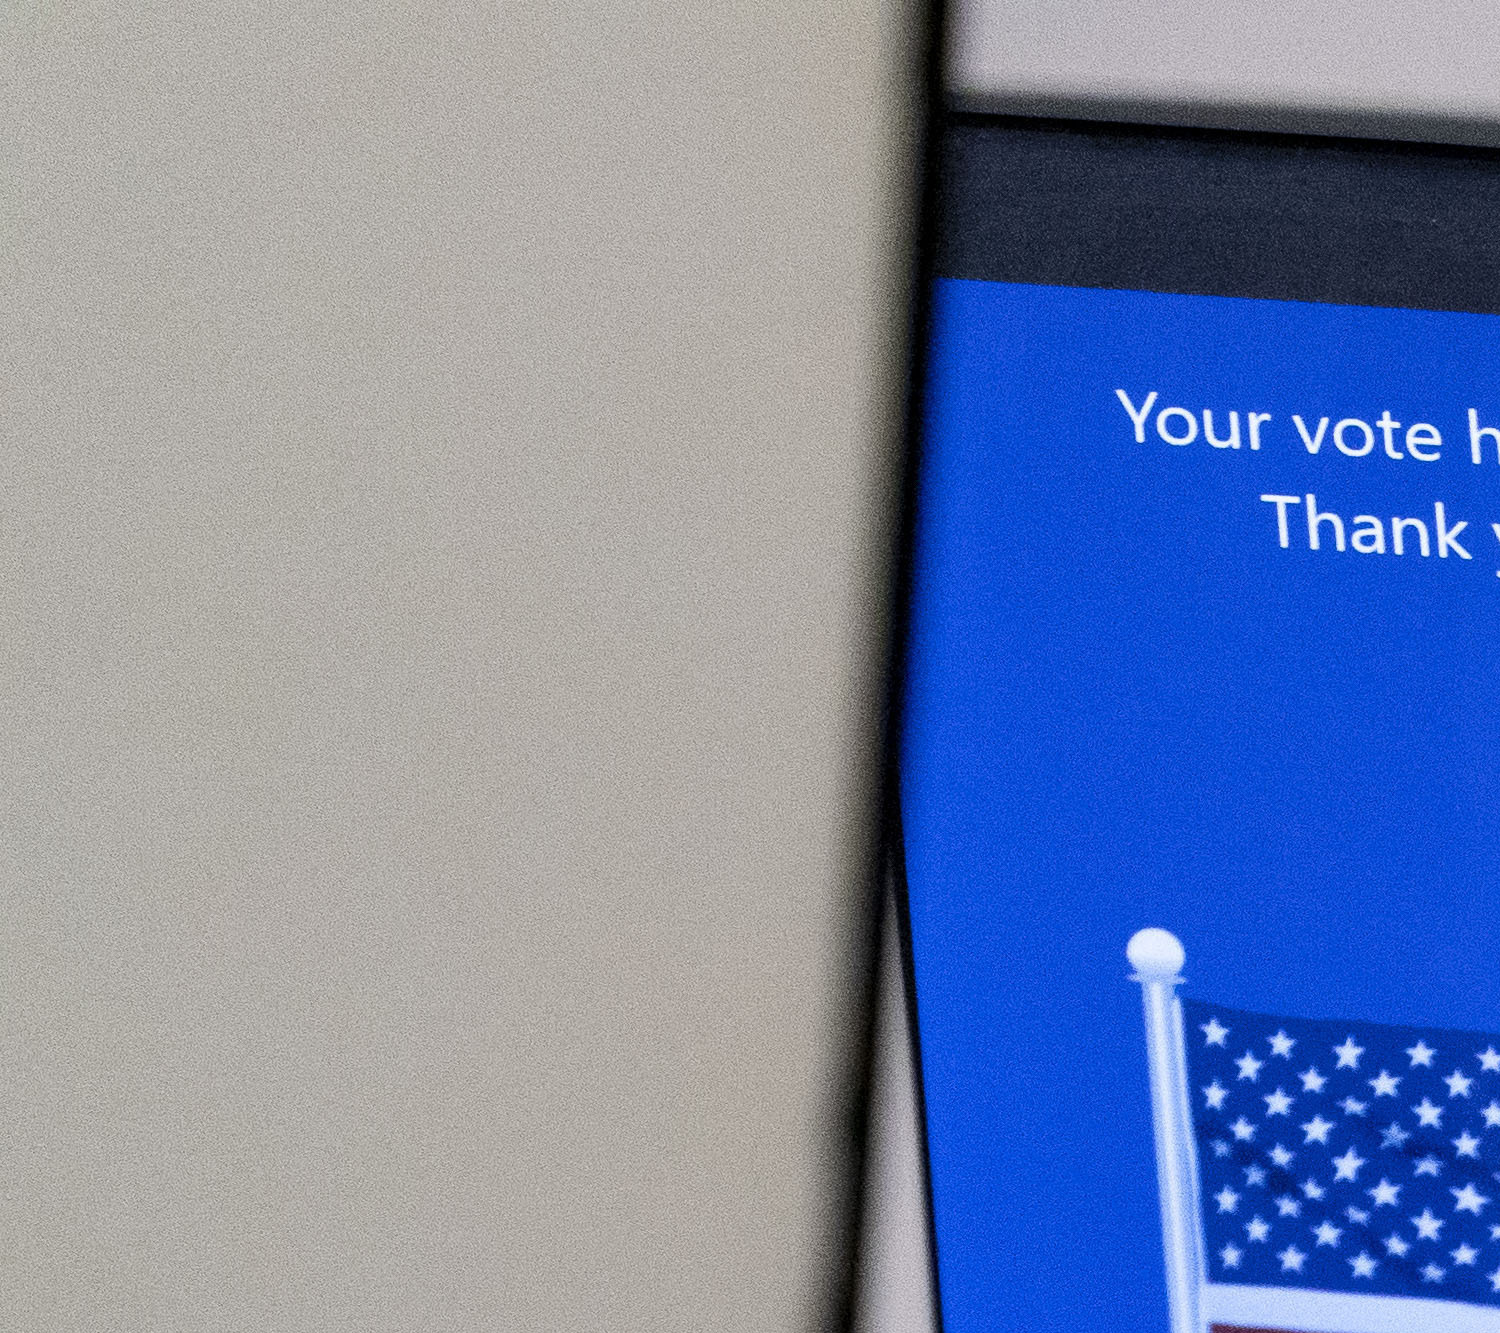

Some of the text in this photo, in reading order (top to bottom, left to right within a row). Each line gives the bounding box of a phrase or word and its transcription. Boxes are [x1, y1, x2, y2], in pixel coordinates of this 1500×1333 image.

[1115, 388, 1272, 452] Your
[1291, 409, 1444, 463] vote
[1259, 492, 1473, 561] Thank
